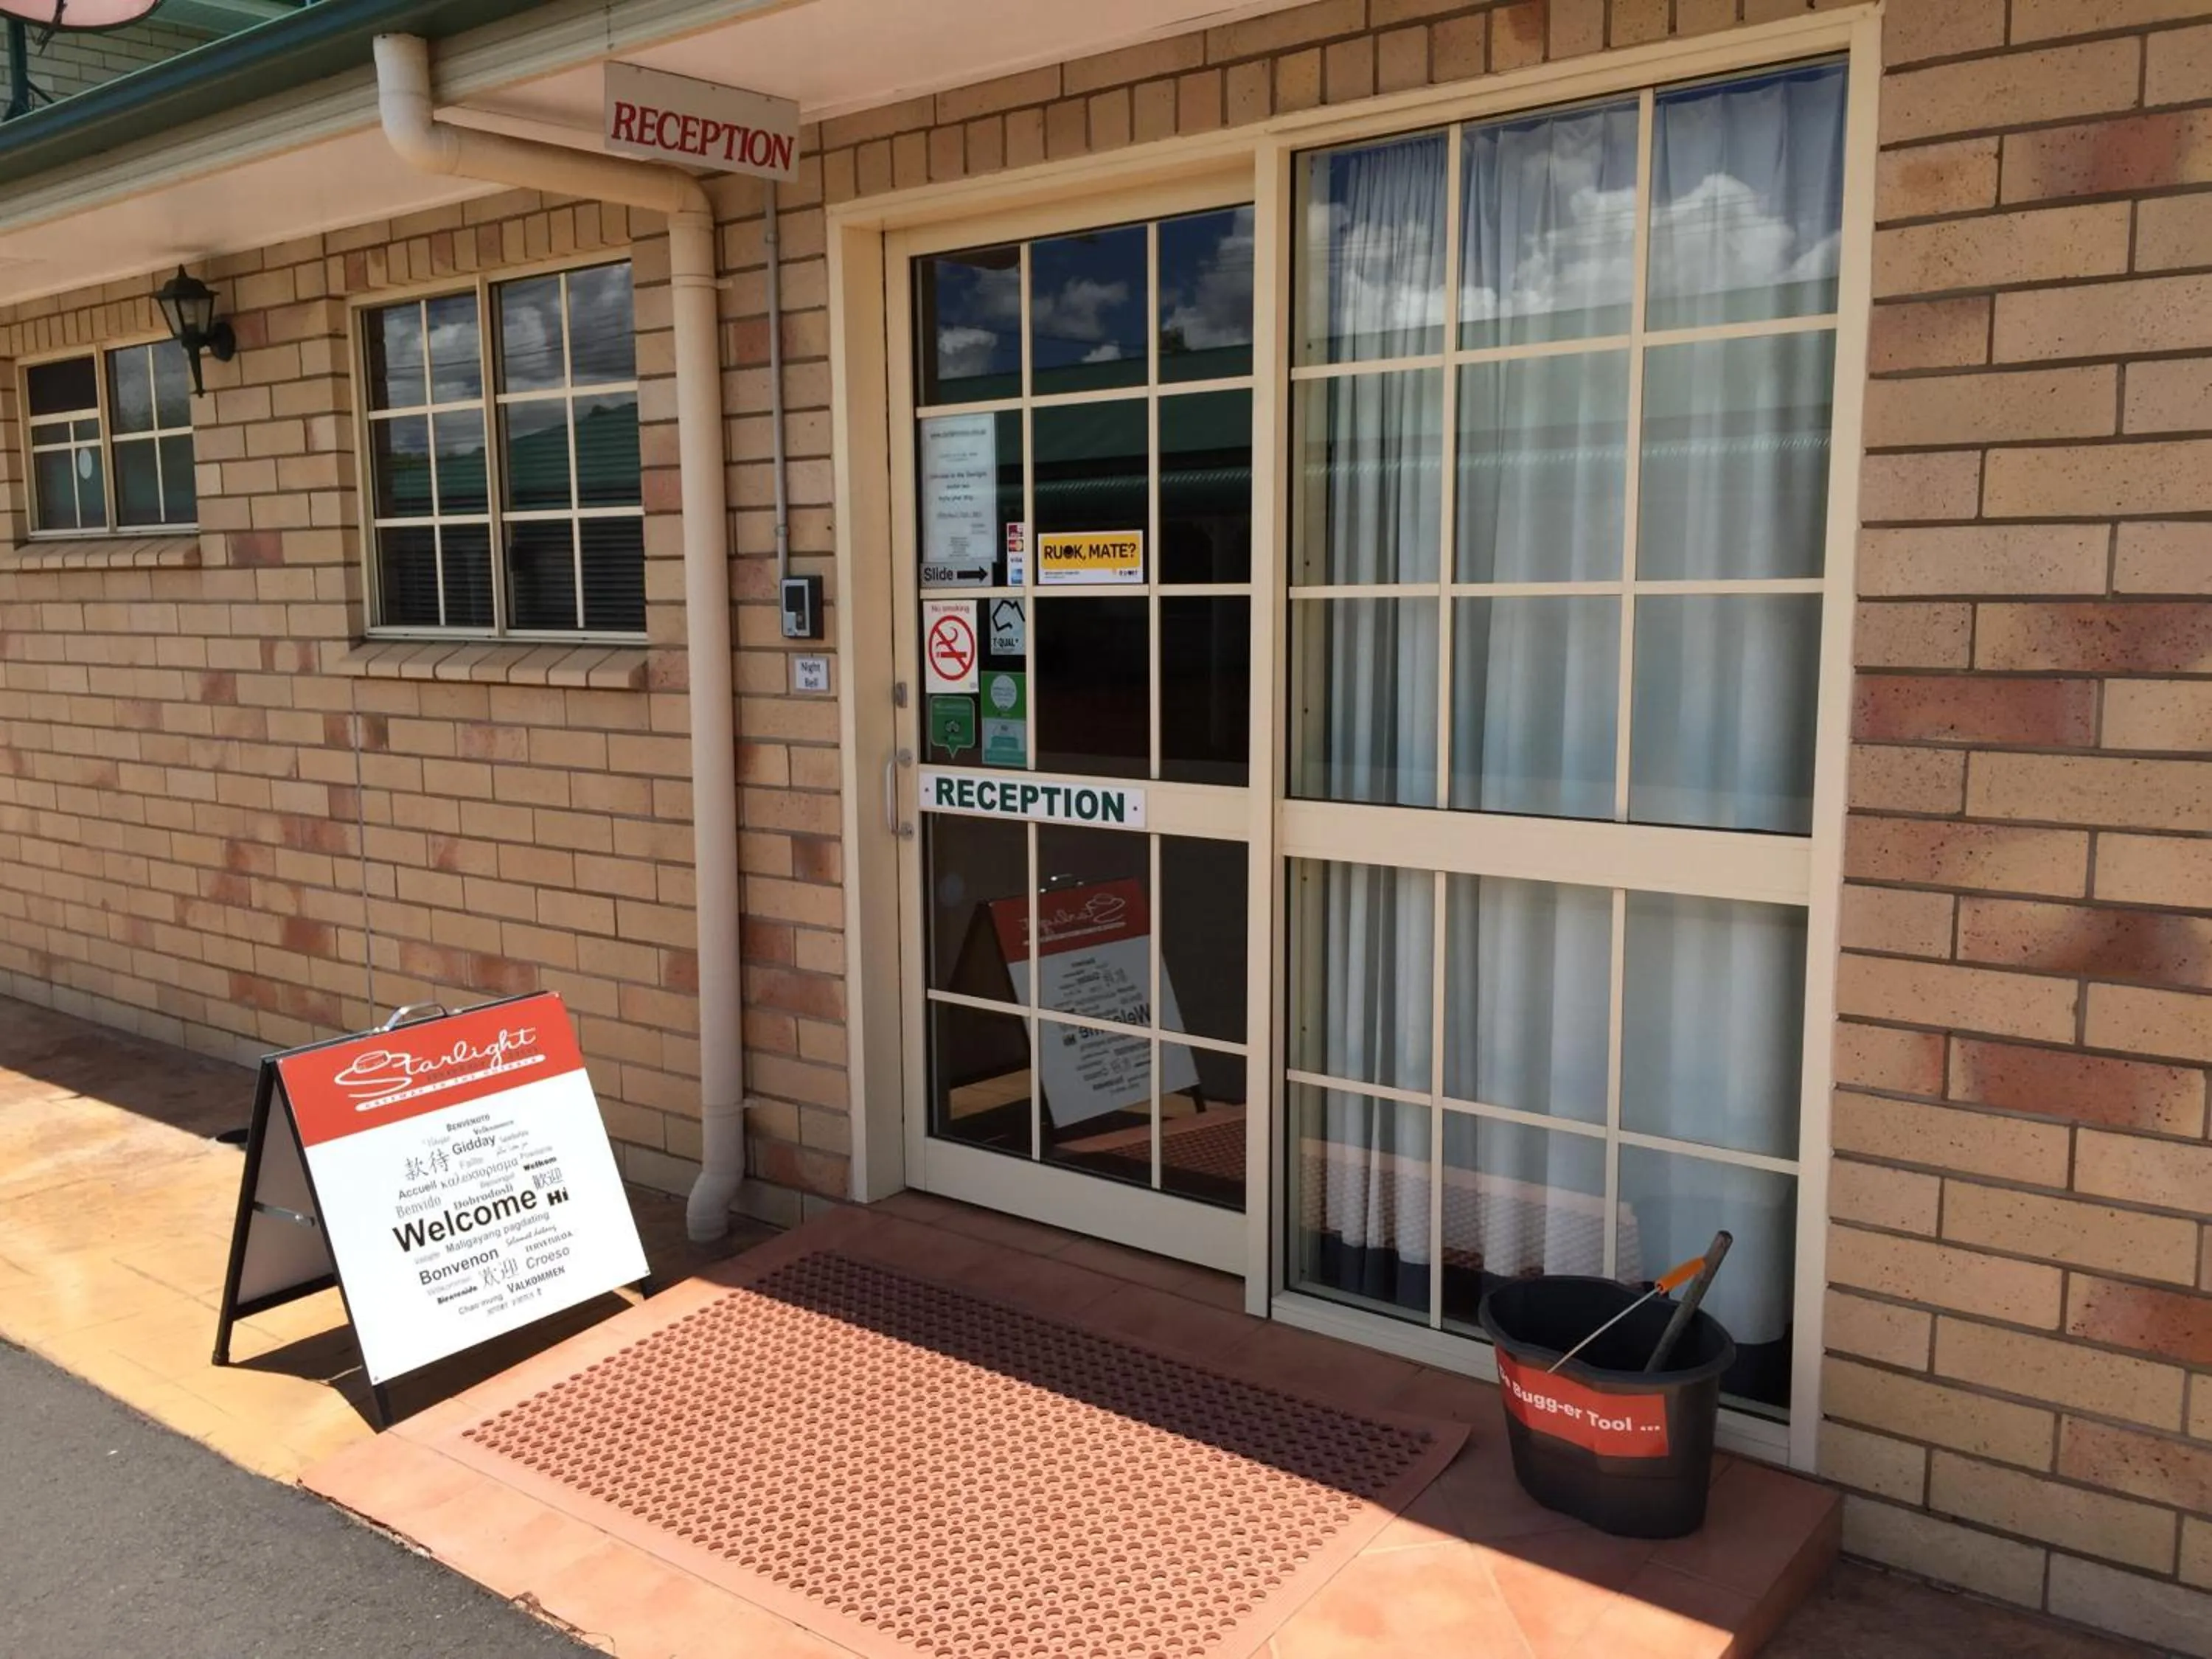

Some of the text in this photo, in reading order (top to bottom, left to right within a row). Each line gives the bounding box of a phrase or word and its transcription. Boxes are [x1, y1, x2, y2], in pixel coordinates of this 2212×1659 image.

[611, 102, 794, 171] RECEPTION
[1089, 543, 1136, 559] MATE?
[923, 566, 954, 582] Slide
[942, 605, 970, 614] smoking
[935, 777, 1125, 823] RECEPTION
[334, 1027, 537, 1099] Starlight
[452, 1135, 496, 1155] Gidday
[398, 1179, 438, 1200] Accueil
[547, 1186, 569, 1206] Hi
[395, 1194, 442, 1219] Benvido
[392, 1189, 538, 1253] Welcome
[445, 1211, 550, 1253] Maligayang pagdating
[419, 1248, 500, 1286] Bonvenon
[525, 1246, 570, 1270] Croeso
[1512, 1380, 1583, 1419] Bugg-er
[1587, 1411, 1632, 1431] Tool
